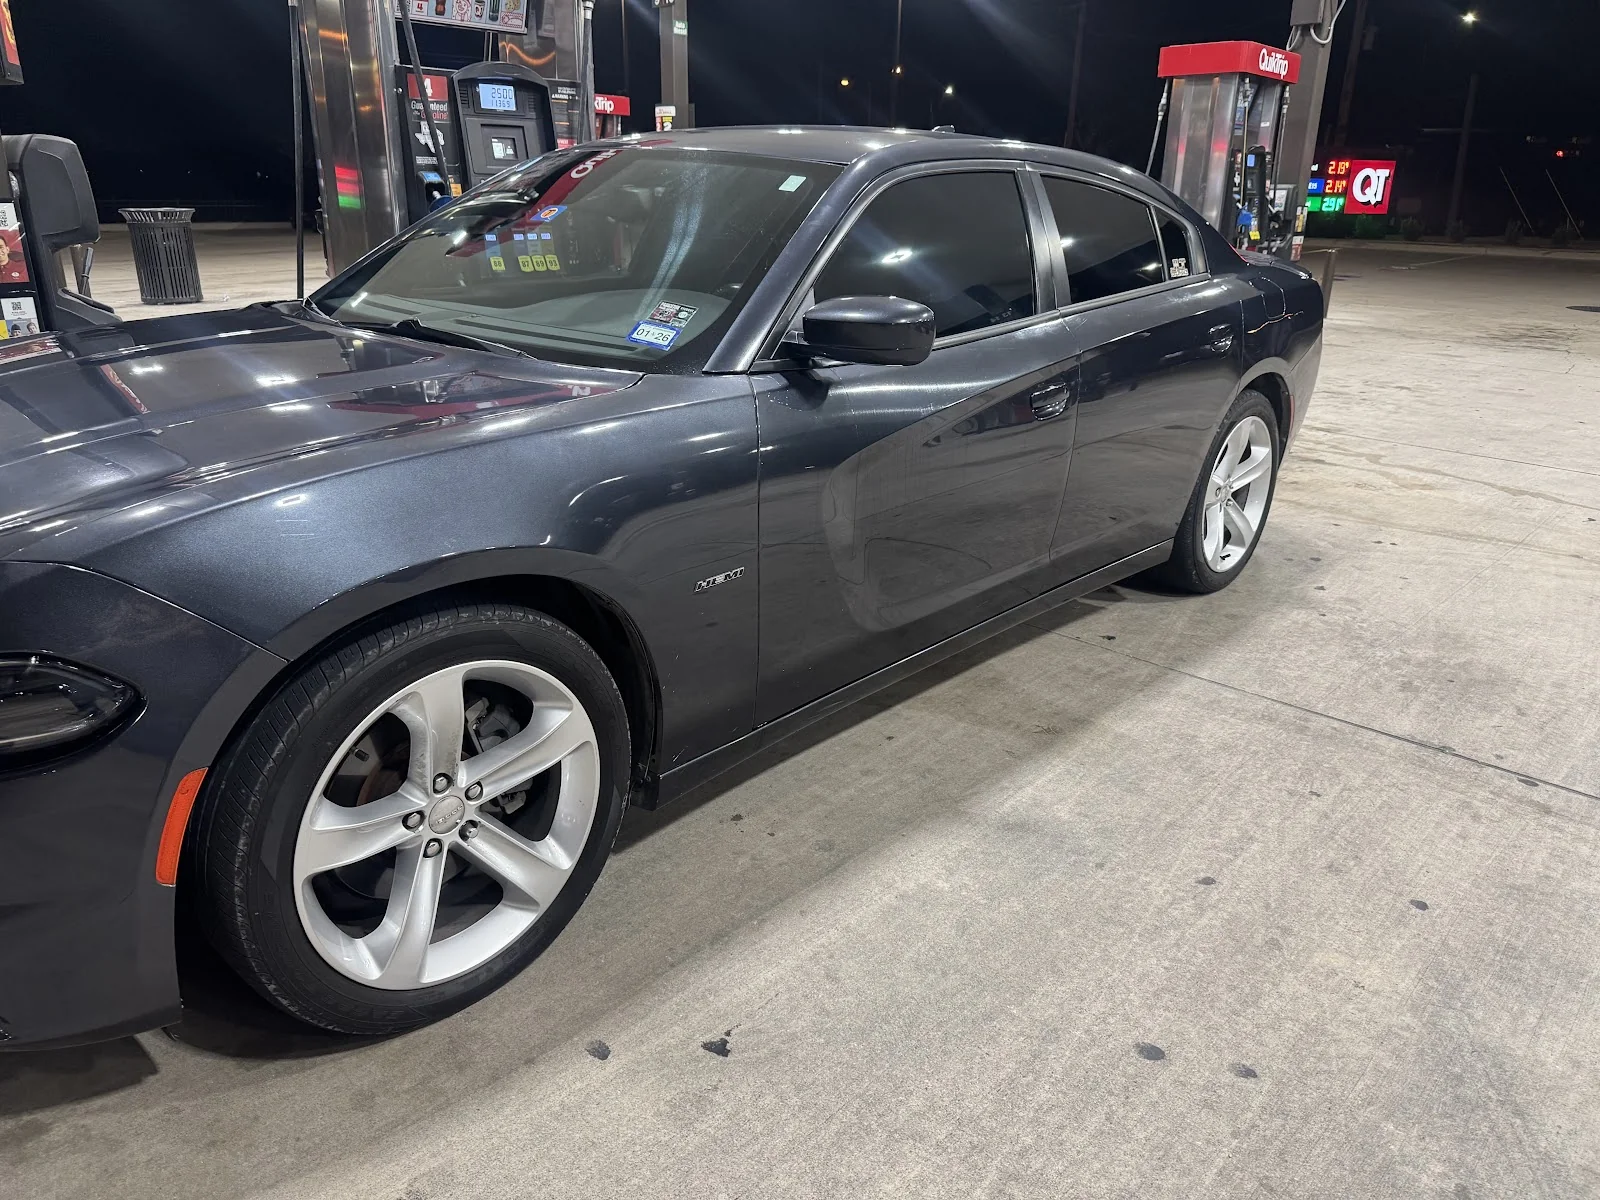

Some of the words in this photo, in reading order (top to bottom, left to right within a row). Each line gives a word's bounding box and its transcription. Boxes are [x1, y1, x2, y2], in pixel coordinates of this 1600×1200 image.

[1259, 48, 1289, 79] QuikTrip
[411, 100, 448, 111] Guanteed
[594, 96, 614, 114] kTrip
[420, 109, 448, 119] Goline
[1352, 167, 1391, 206] QT
[521, 260, 530, 268] 87
[548, 259, 558, 267] 93
[636, 328, 651, 338] 01
[654, 332, 671, 342] 26
[693, 566, 745, 593] HEMI
